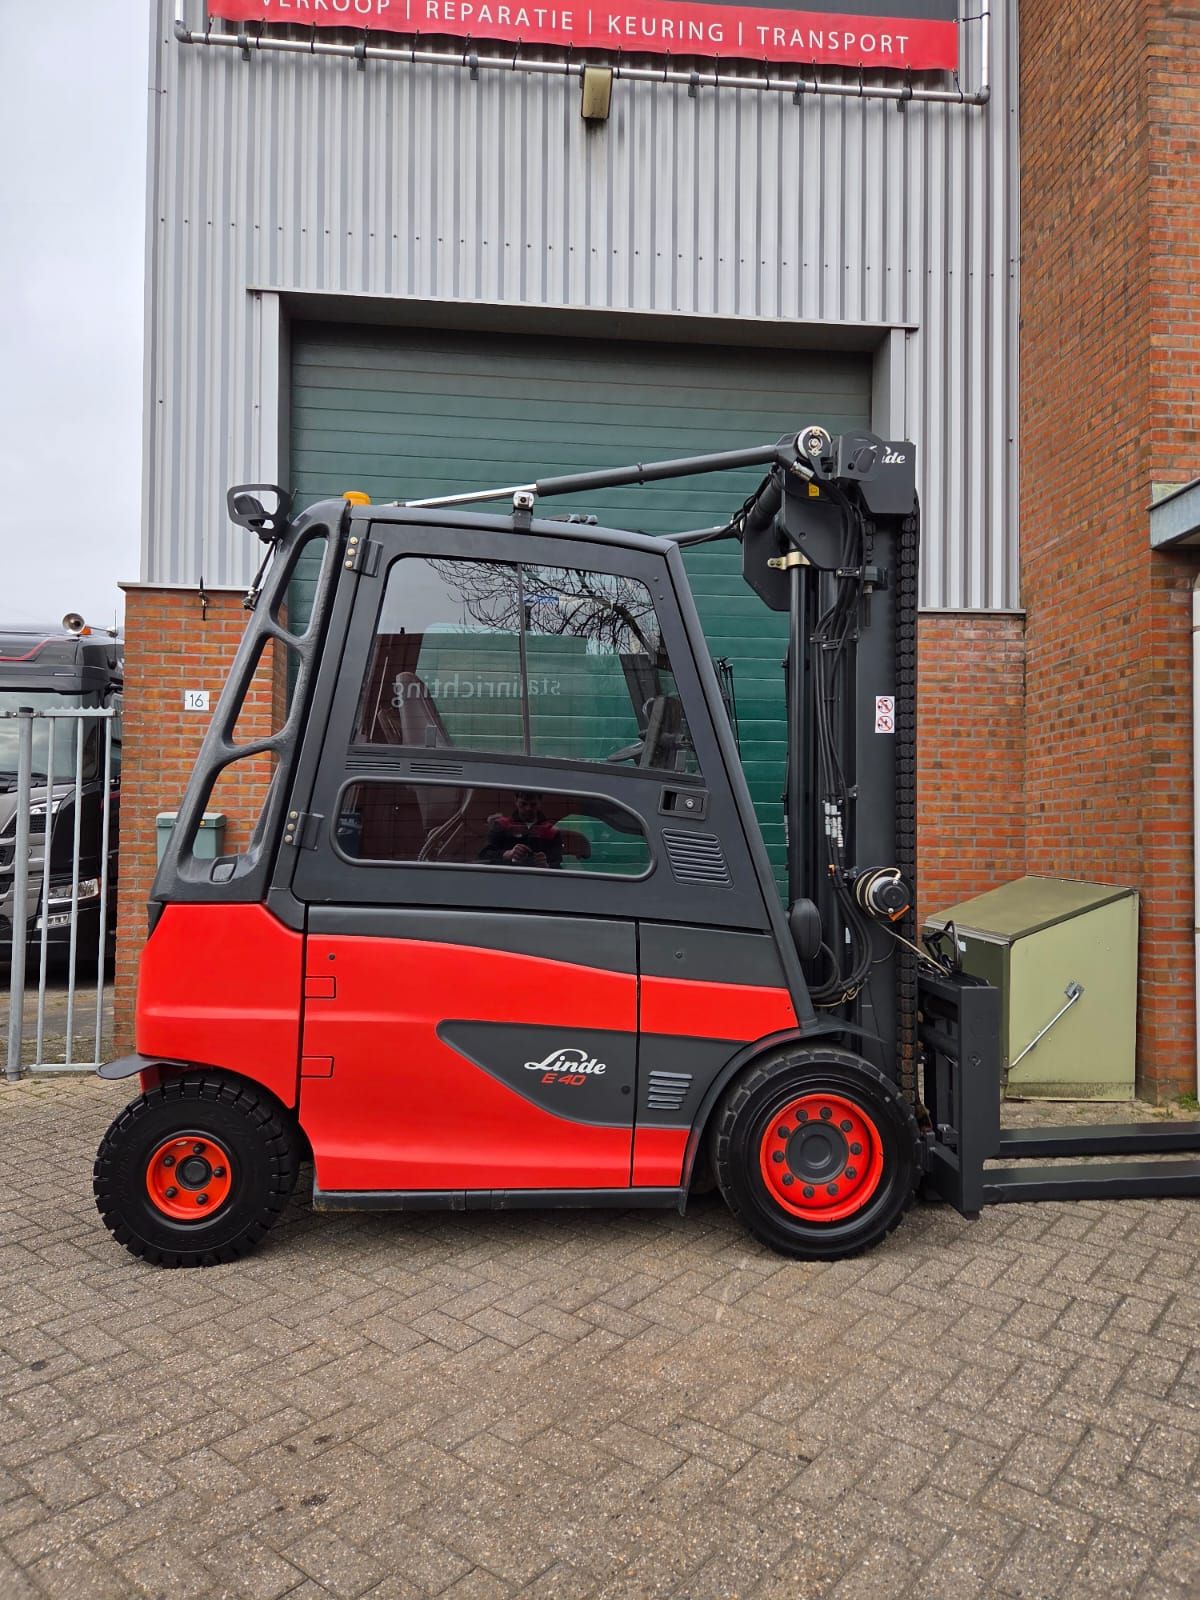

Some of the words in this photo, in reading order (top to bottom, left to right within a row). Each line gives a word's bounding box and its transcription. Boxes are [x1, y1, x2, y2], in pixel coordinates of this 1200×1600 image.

[426, 0, 574, 30] REPARATIE
[608, 14, 723, 42] KEURING
[756, 26, 909, 54] TRANSPORT
[189, 693, 204, 708] 16
[524, 1048, 606, 1075] Linde
